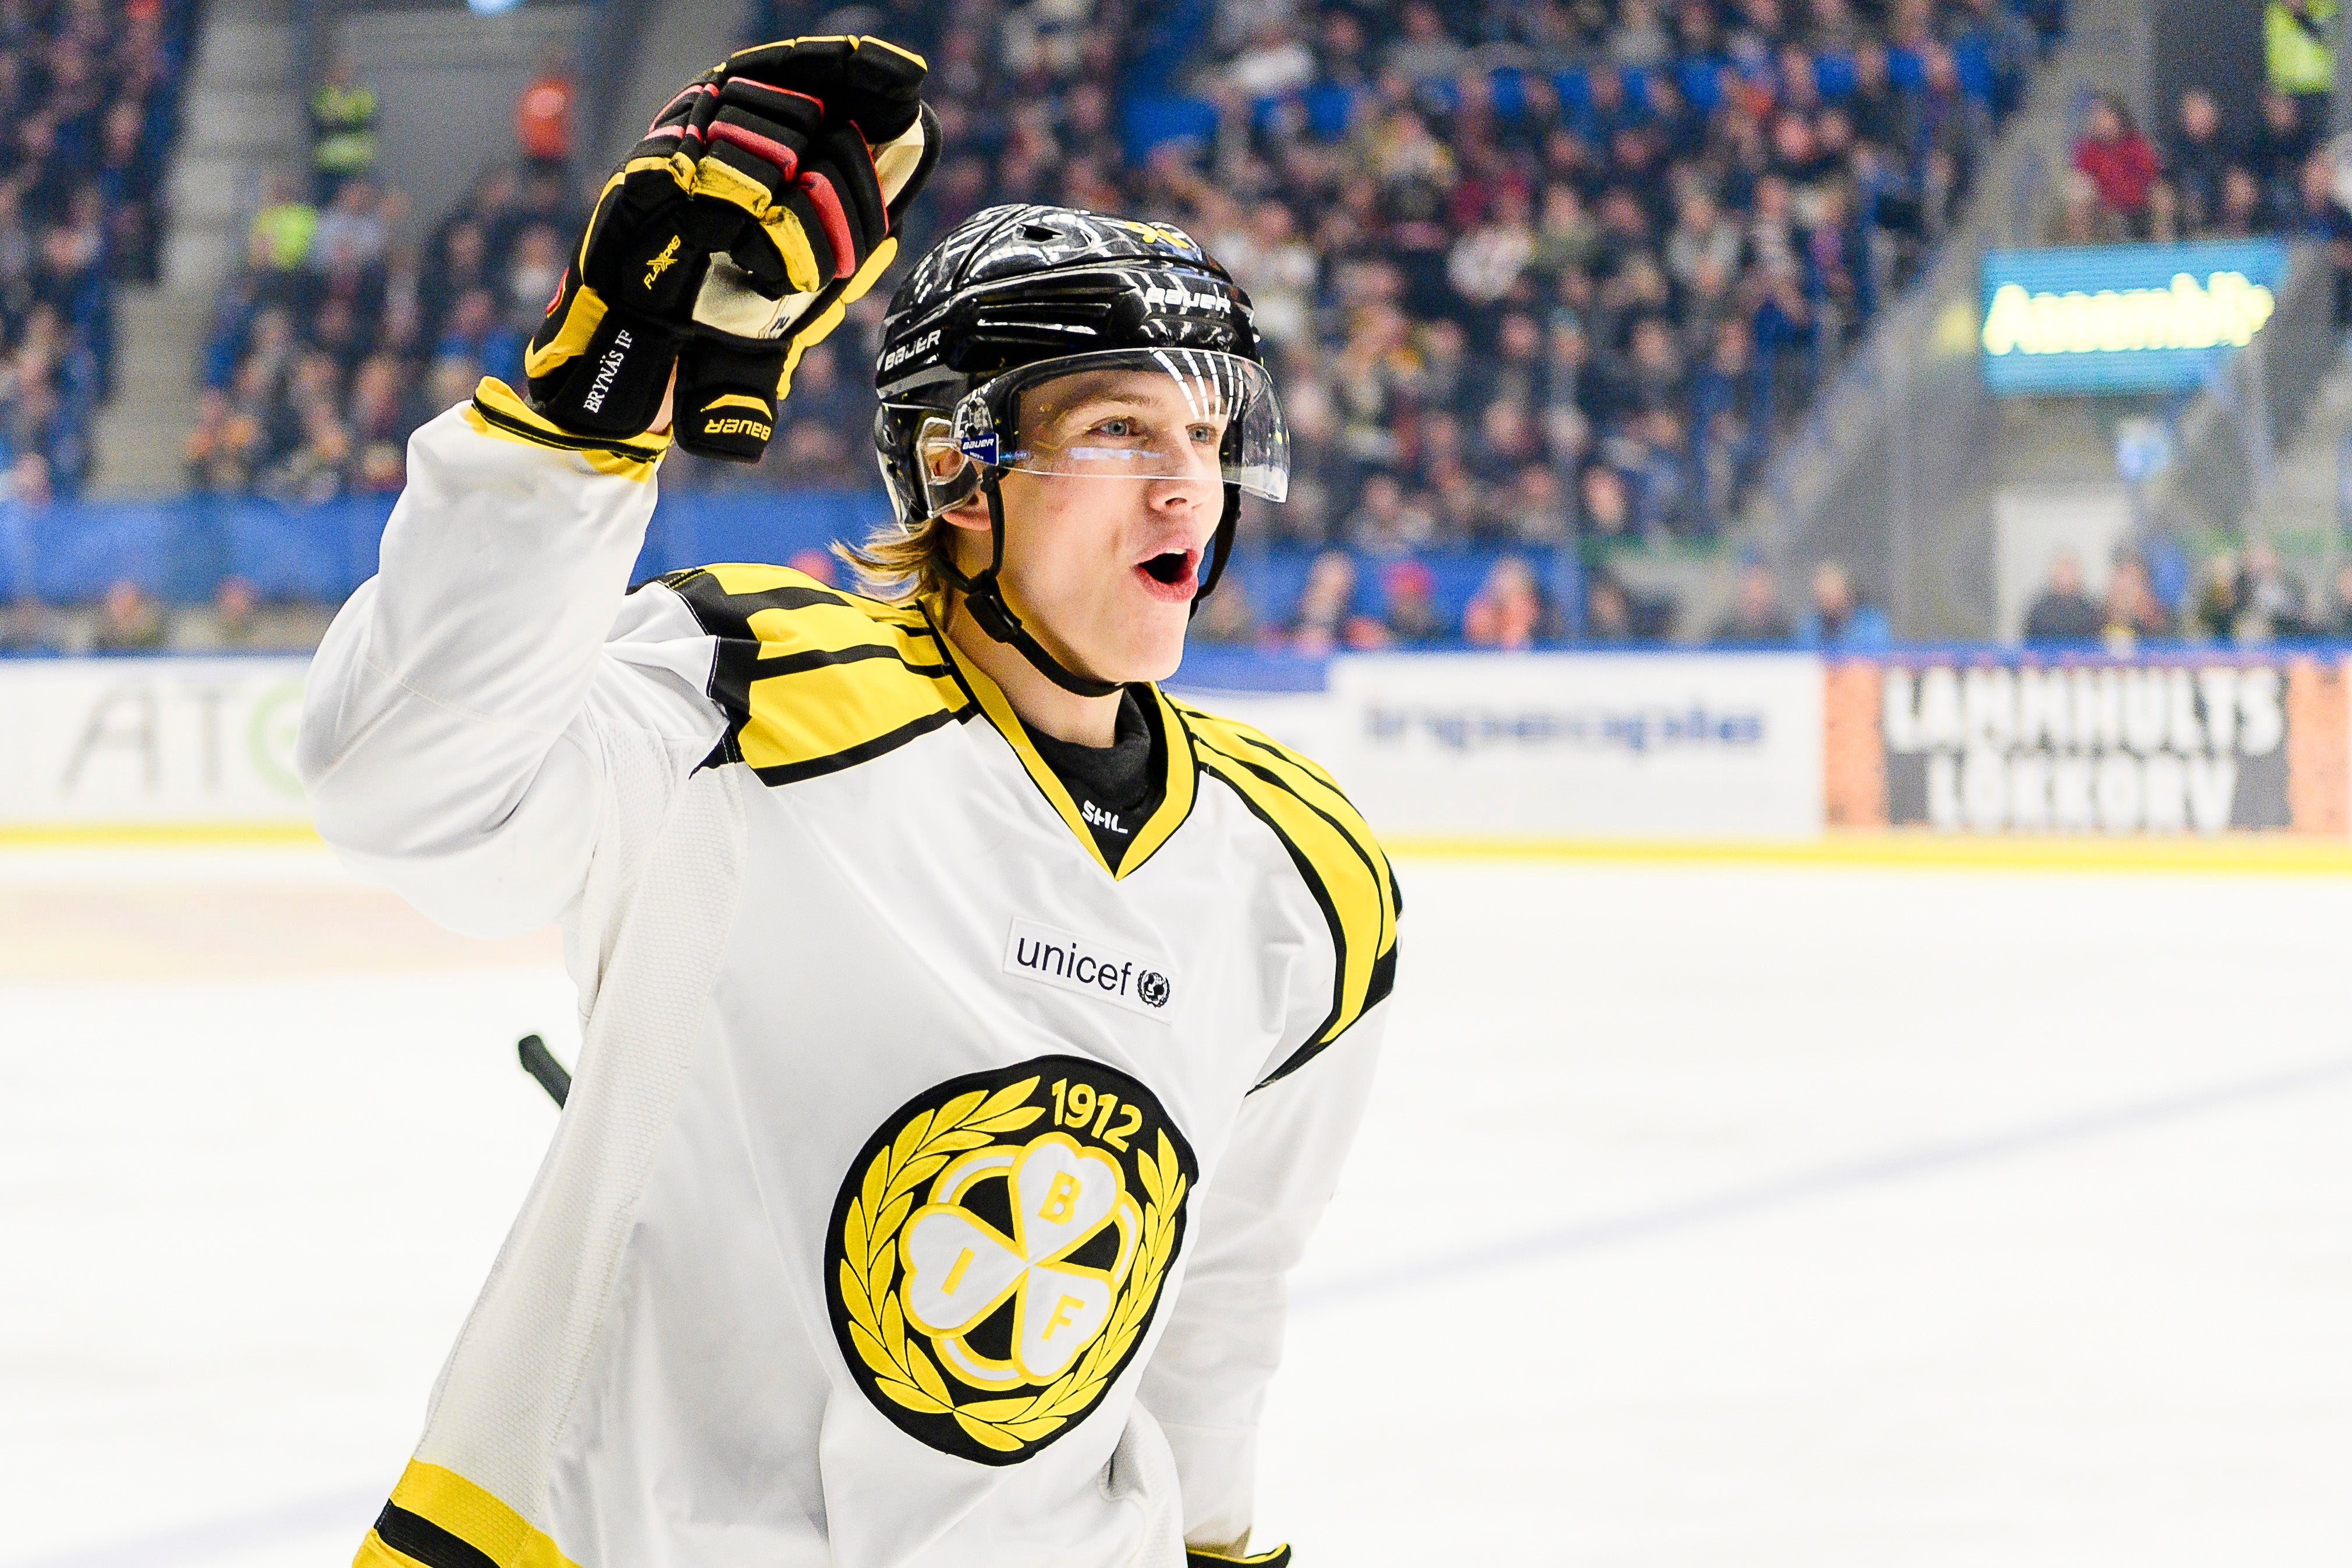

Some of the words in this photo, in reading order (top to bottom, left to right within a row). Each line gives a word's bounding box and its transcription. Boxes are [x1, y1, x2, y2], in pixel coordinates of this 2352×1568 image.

[583, 350, 625, 413] BRYNÄS
[615, 329, 633, 349] IF
[884, 329, 941, 372] BAUER
[704, 418, 772, 441] BAUER
[1081, 800, 1128, 834] SHL
[1017, 937, 1133, 996] unicef
[1052, 1078, 1143, 1152] 1912
[1037, 1170, 1083, 1225] B
[941, 1247, 975, 1296] I
[1041, 1293, 1085, 1341] F
